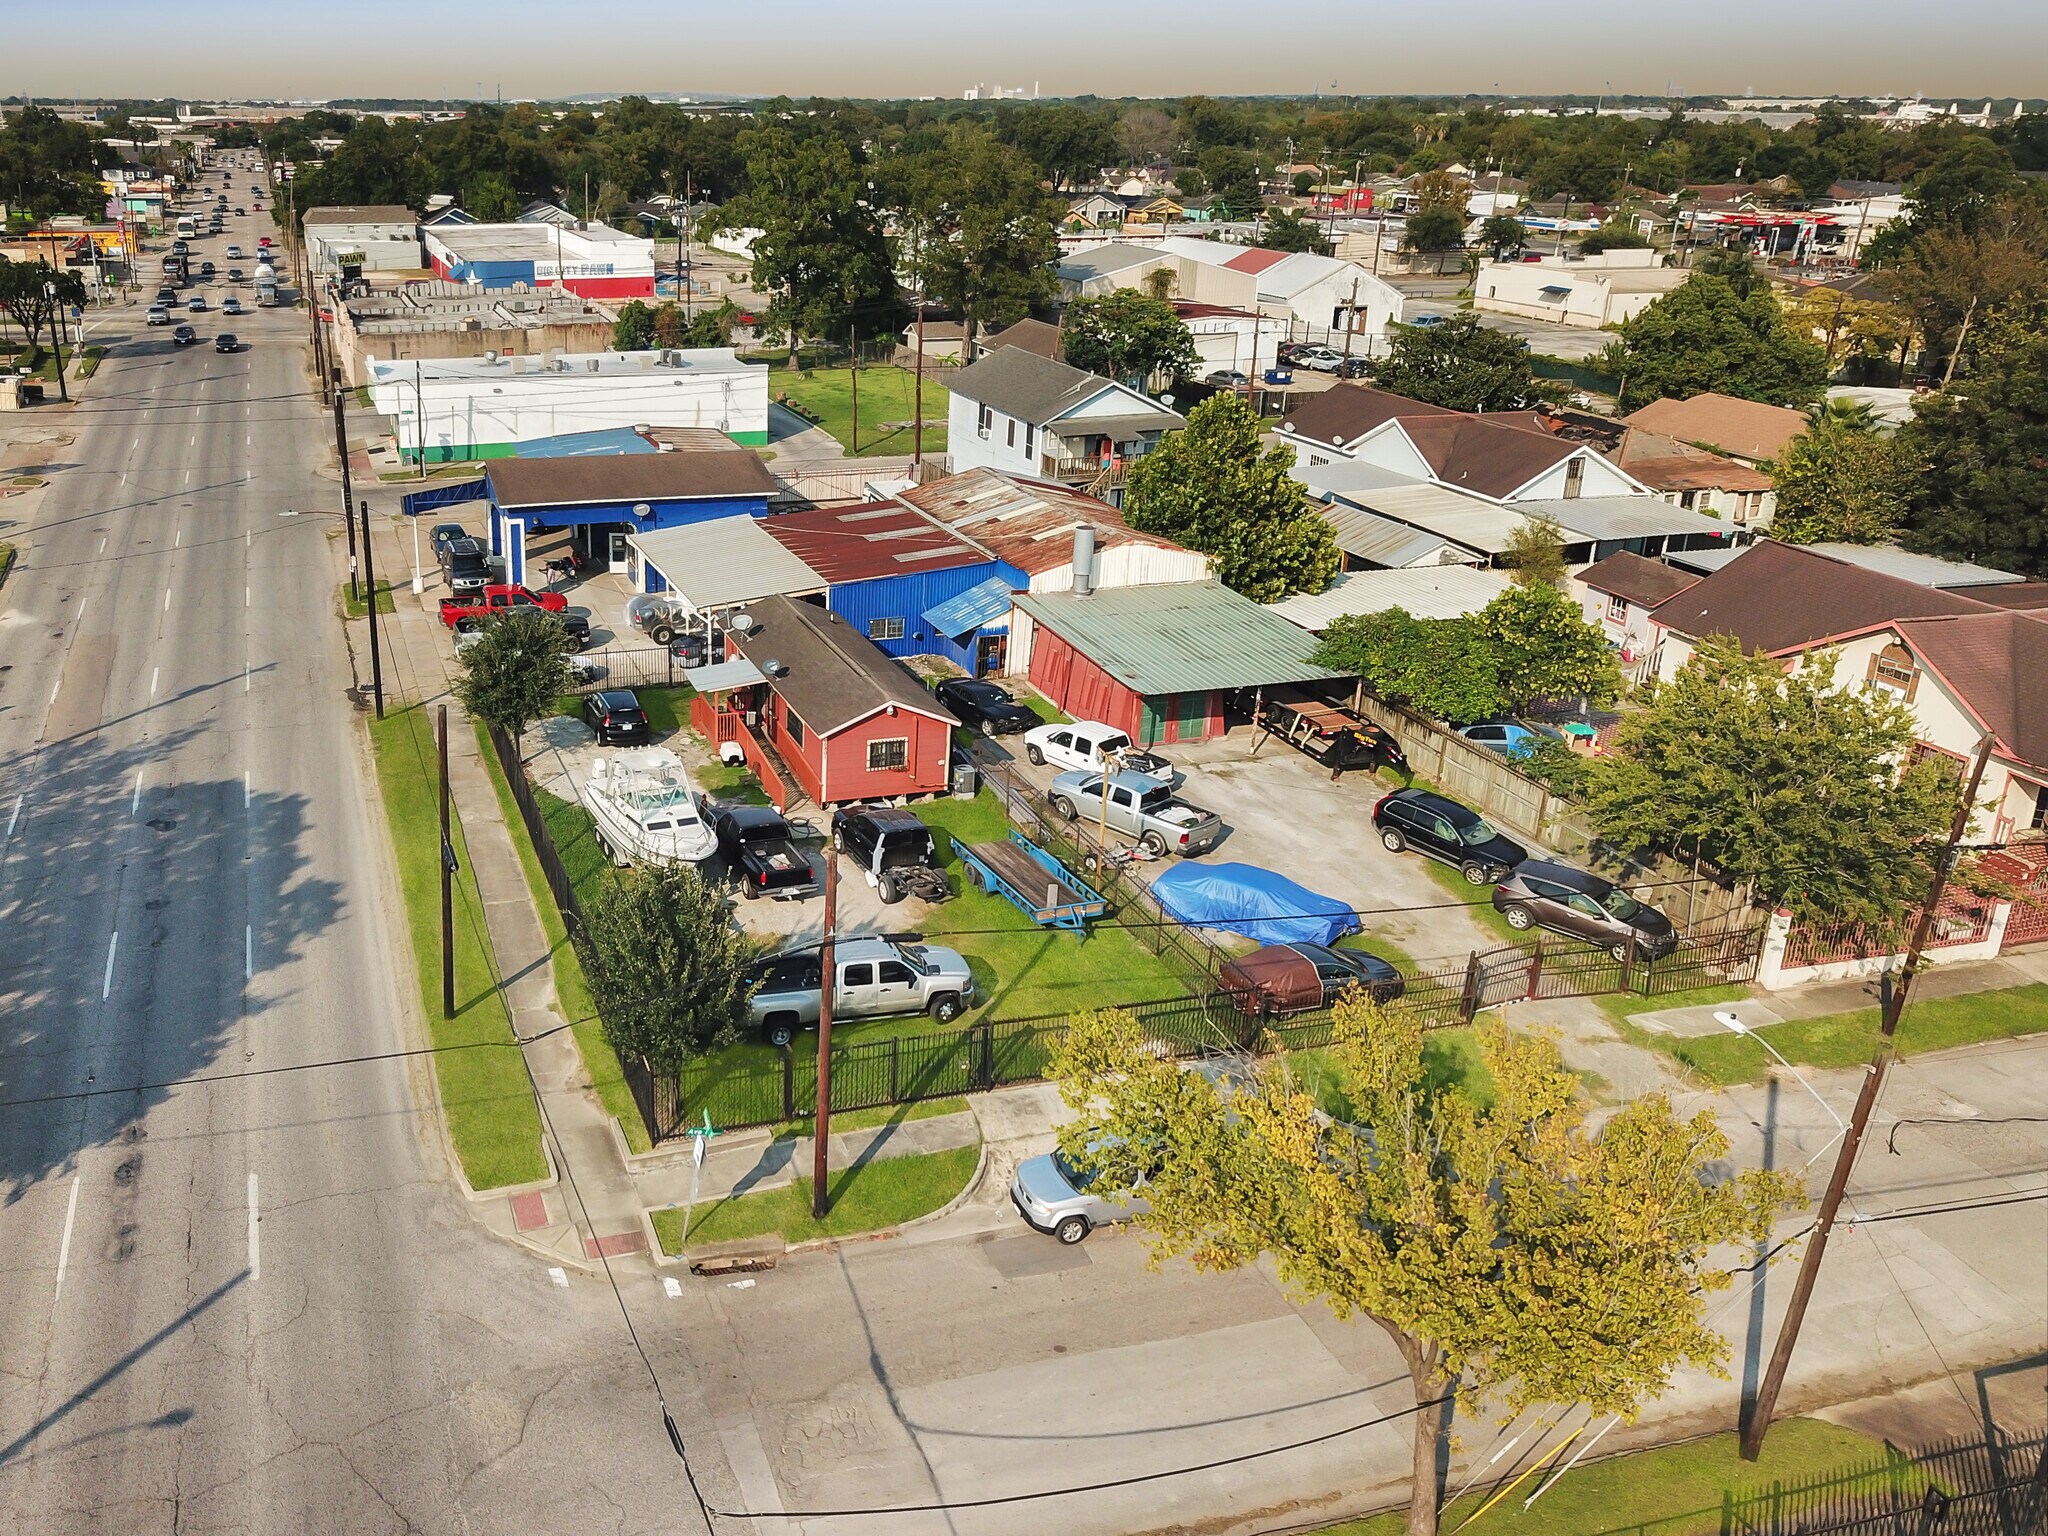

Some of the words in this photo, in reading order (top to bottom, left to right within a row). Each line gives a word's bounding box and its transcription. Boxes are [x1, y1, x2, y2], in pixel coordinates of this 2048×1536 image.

[338, 253, 365, 263] PAWN
[536, 265, 554, 276] BIG
[581, 263, 614, 276] PAWN
